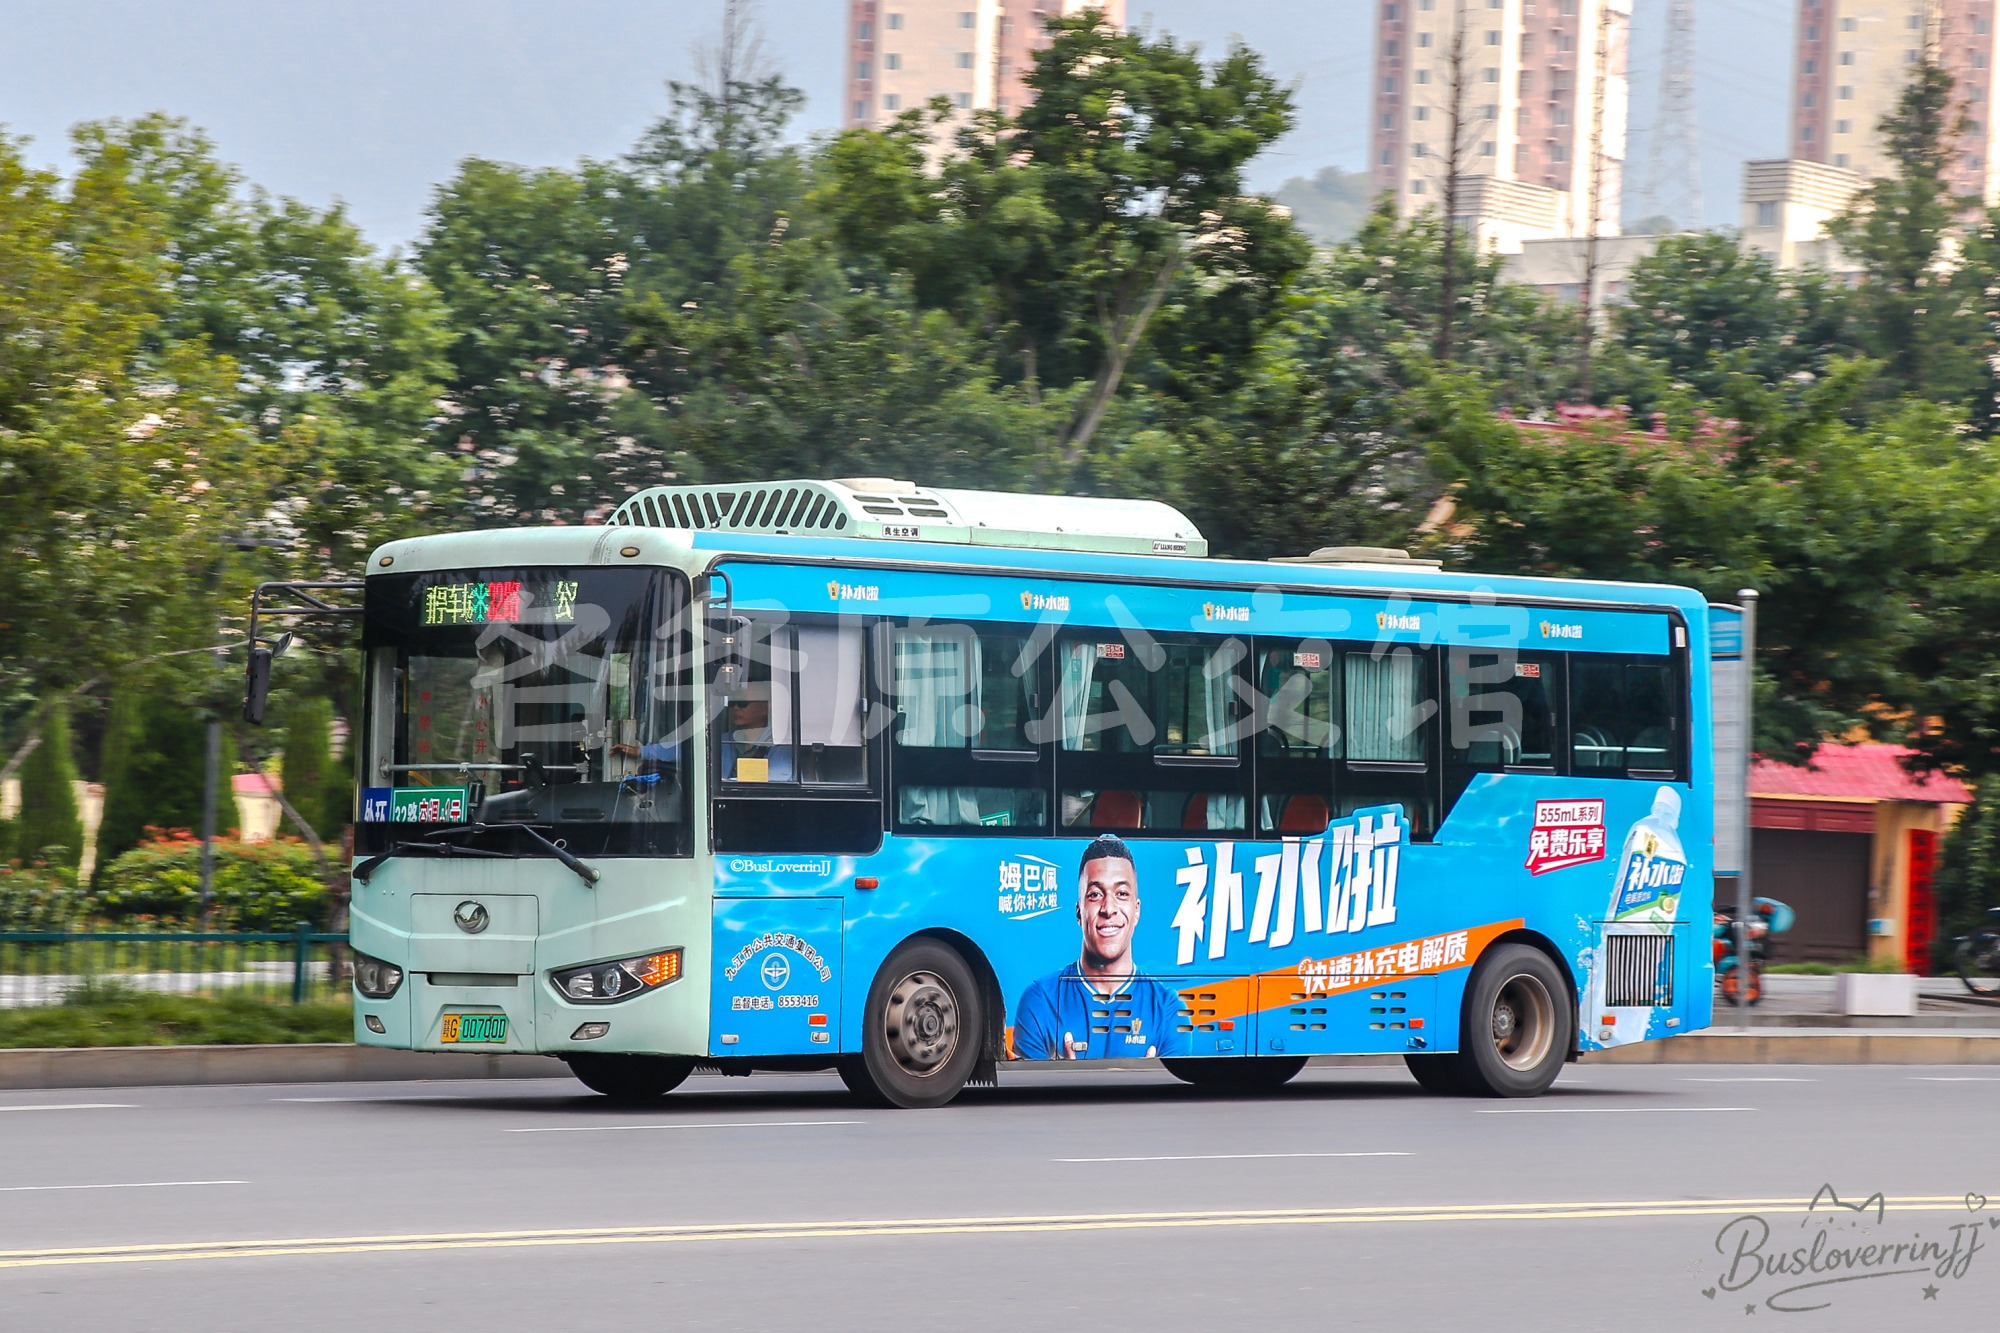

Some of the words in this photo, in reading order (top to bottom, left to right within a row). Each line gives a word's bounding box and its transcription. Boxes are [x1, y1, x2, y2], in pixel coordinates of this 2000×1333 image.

[1525, 827, 1605, 867] 免费乐享
[998, 859, 1059, 893] 姆巴佩
[1170, 812, 1400, 966] 补水啦
[1626, 855, 1685, 892] 补水啦
[998, 892, 1058, 914] 喊你补水啦
[724, 931, 833, 983] 九江市公共交通集团公司
[1302, 930, 1469, 995] 快速补充电解质
